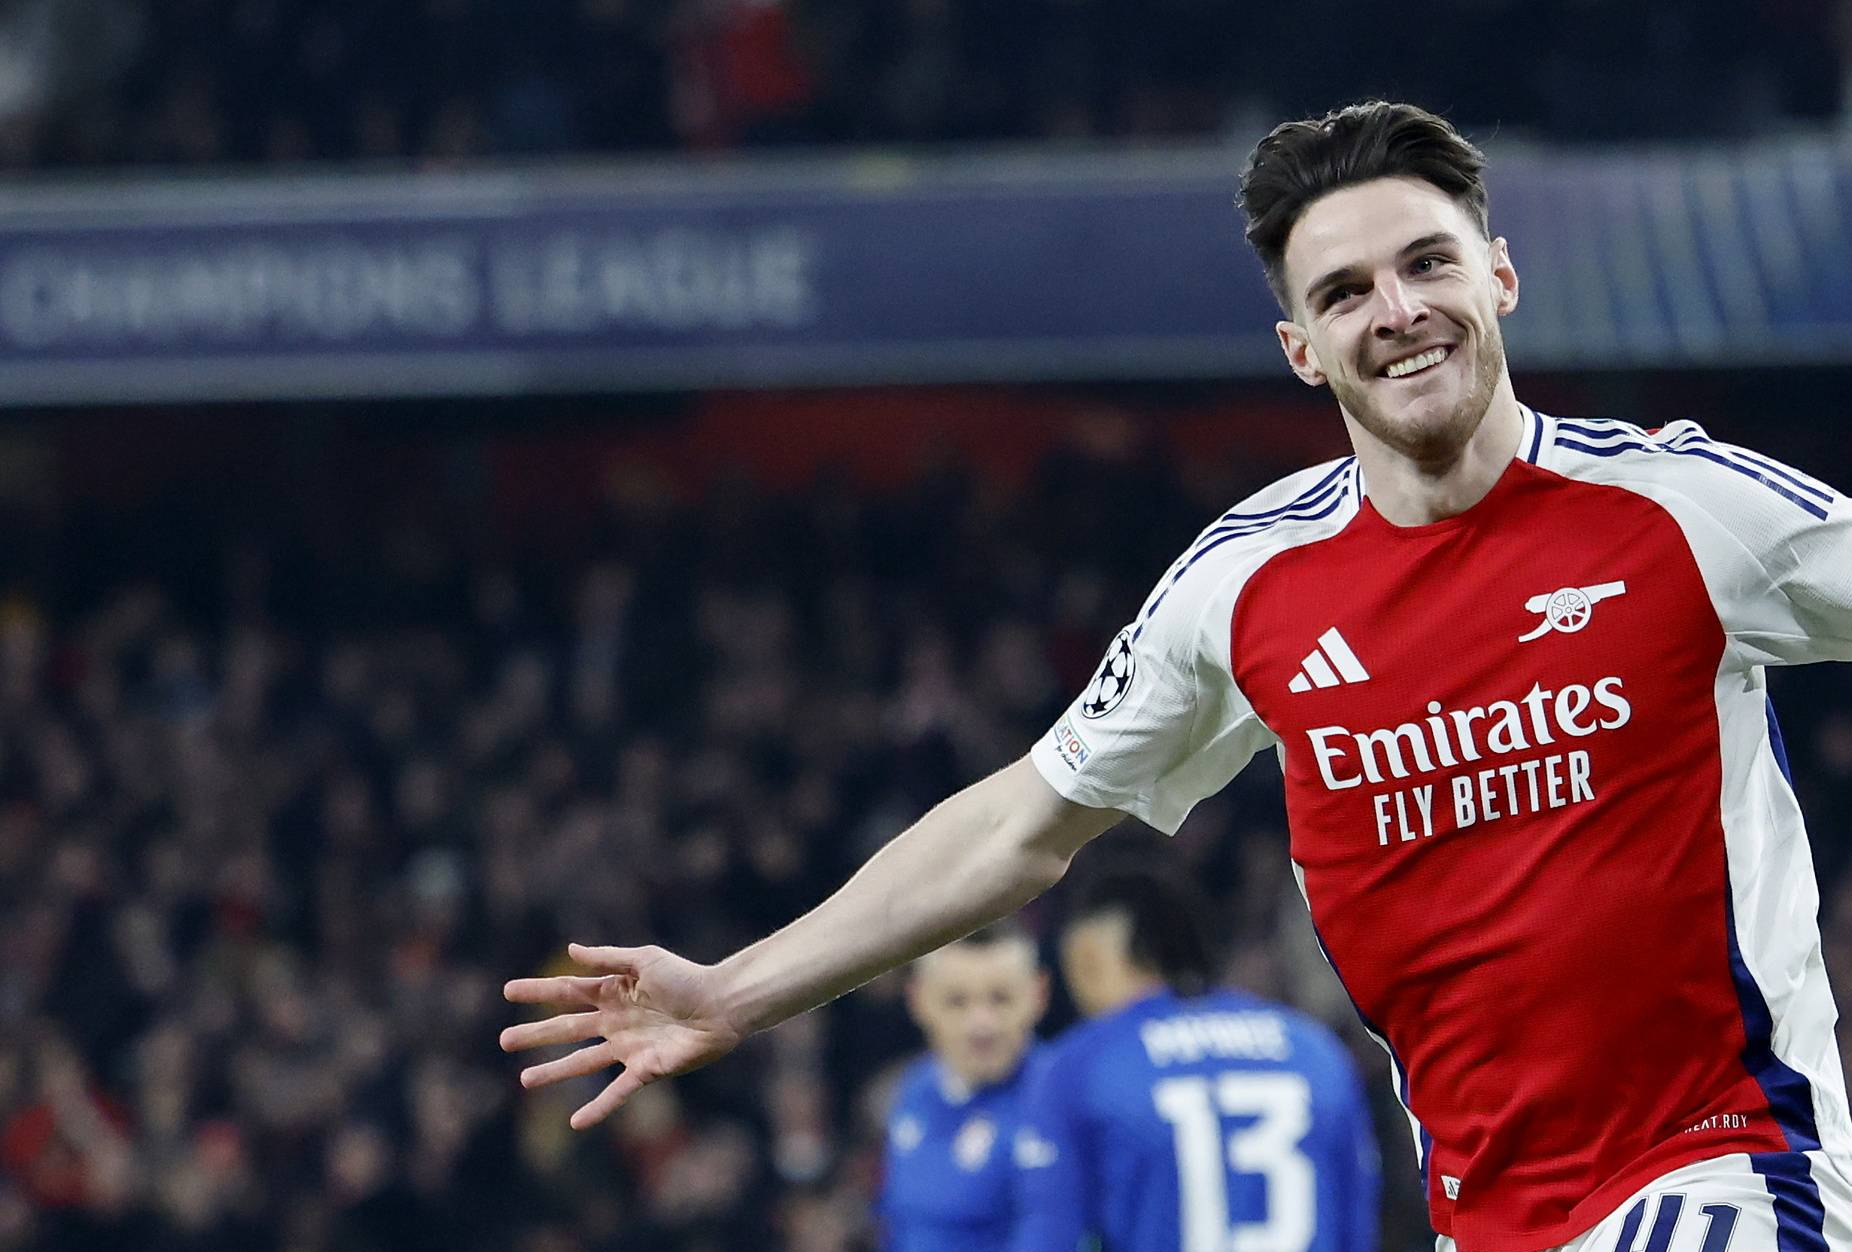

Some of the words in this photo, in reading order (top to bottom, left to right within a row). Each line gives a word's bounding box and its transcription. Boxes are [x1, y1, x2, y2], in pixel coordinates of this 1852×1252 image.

[4, 236, 477, 345] CHAMPIONS
[491, 227, 813, 333] LEAGUE
[1306, 676, 1631, 790] Emirates
[1373, 785, 1434, 846] FLY
[1452, 750, 1596, 829] BETTER
[1684, 1114, 1748, 1134] AT.RDY
